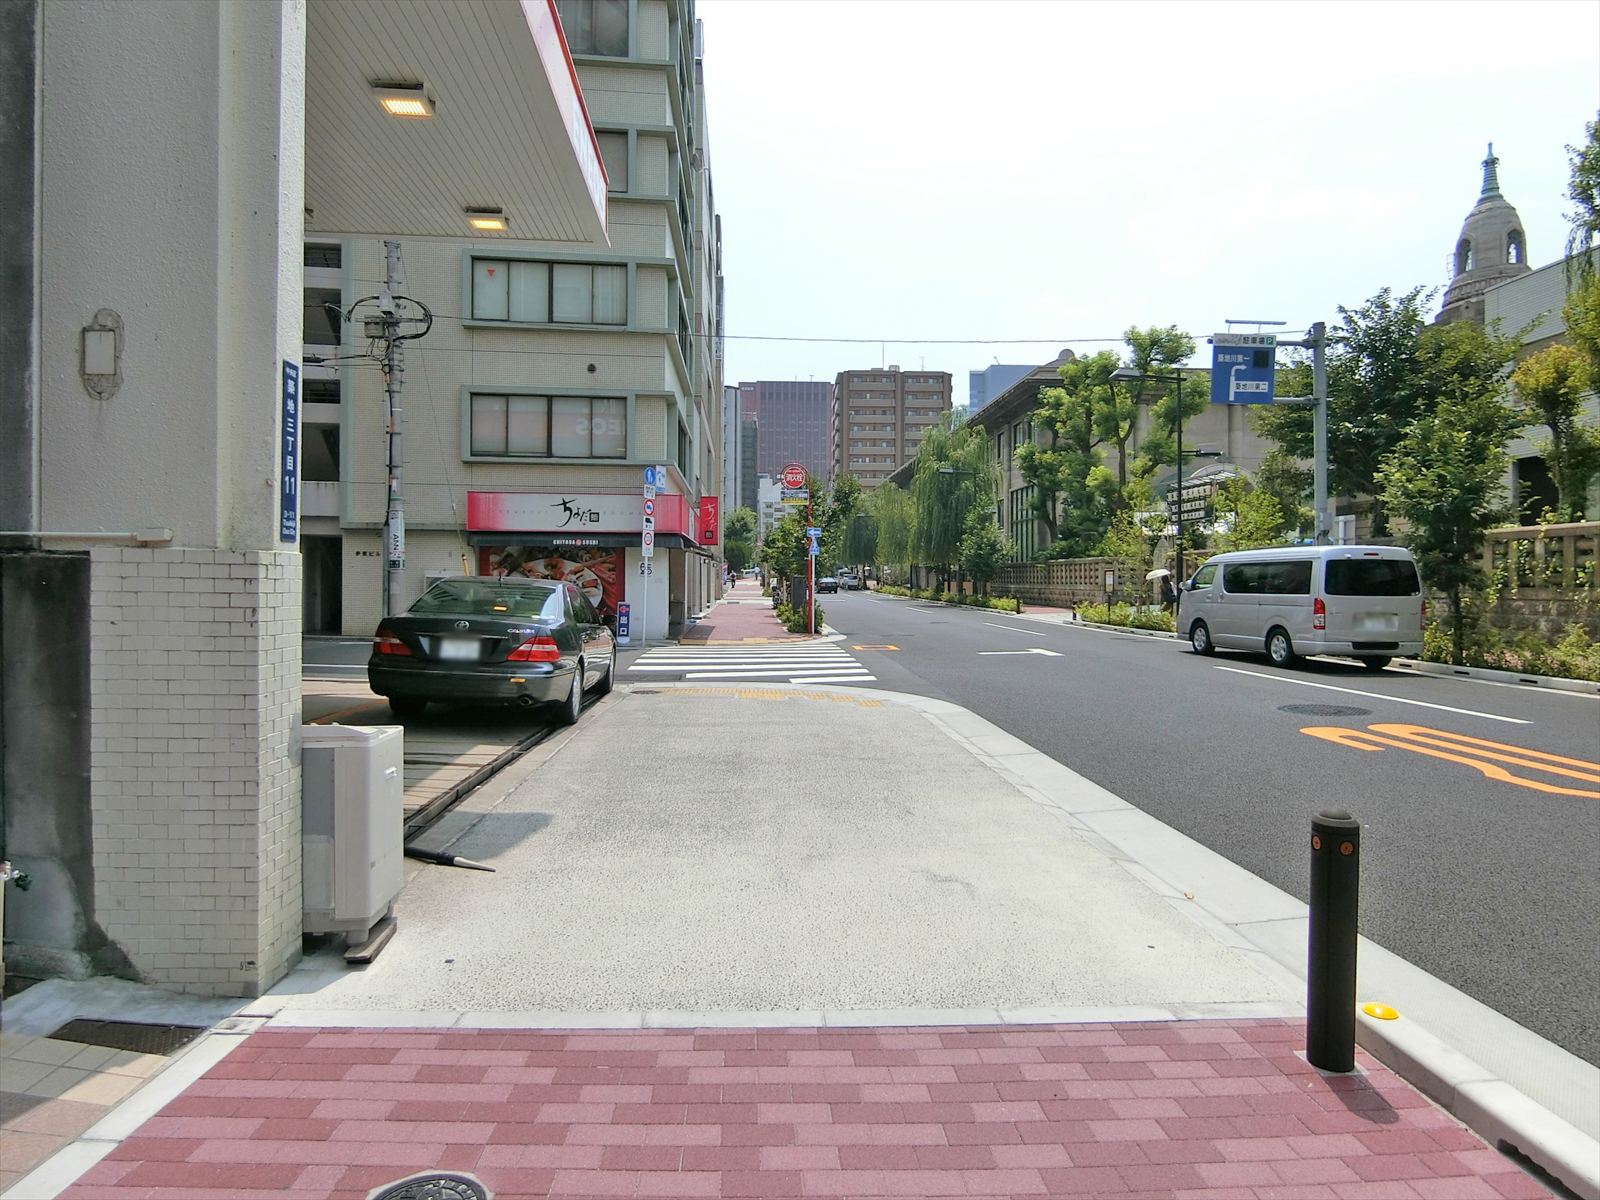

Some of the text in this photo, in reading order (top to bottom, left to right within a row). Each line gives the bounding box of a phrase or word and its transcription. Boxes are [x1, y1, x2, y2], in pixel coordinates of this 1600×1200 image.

[1243, 336, 1266, 345] 駐車場
[1217, 353, 1250, 363] 築地川第一
[1235, 382, 1267, 391] 築地川第二
[785, 473, 803, 482] 消火栓
[283, 510, 295, 518] 3-11
[619, 616, 628, 635] 出口
